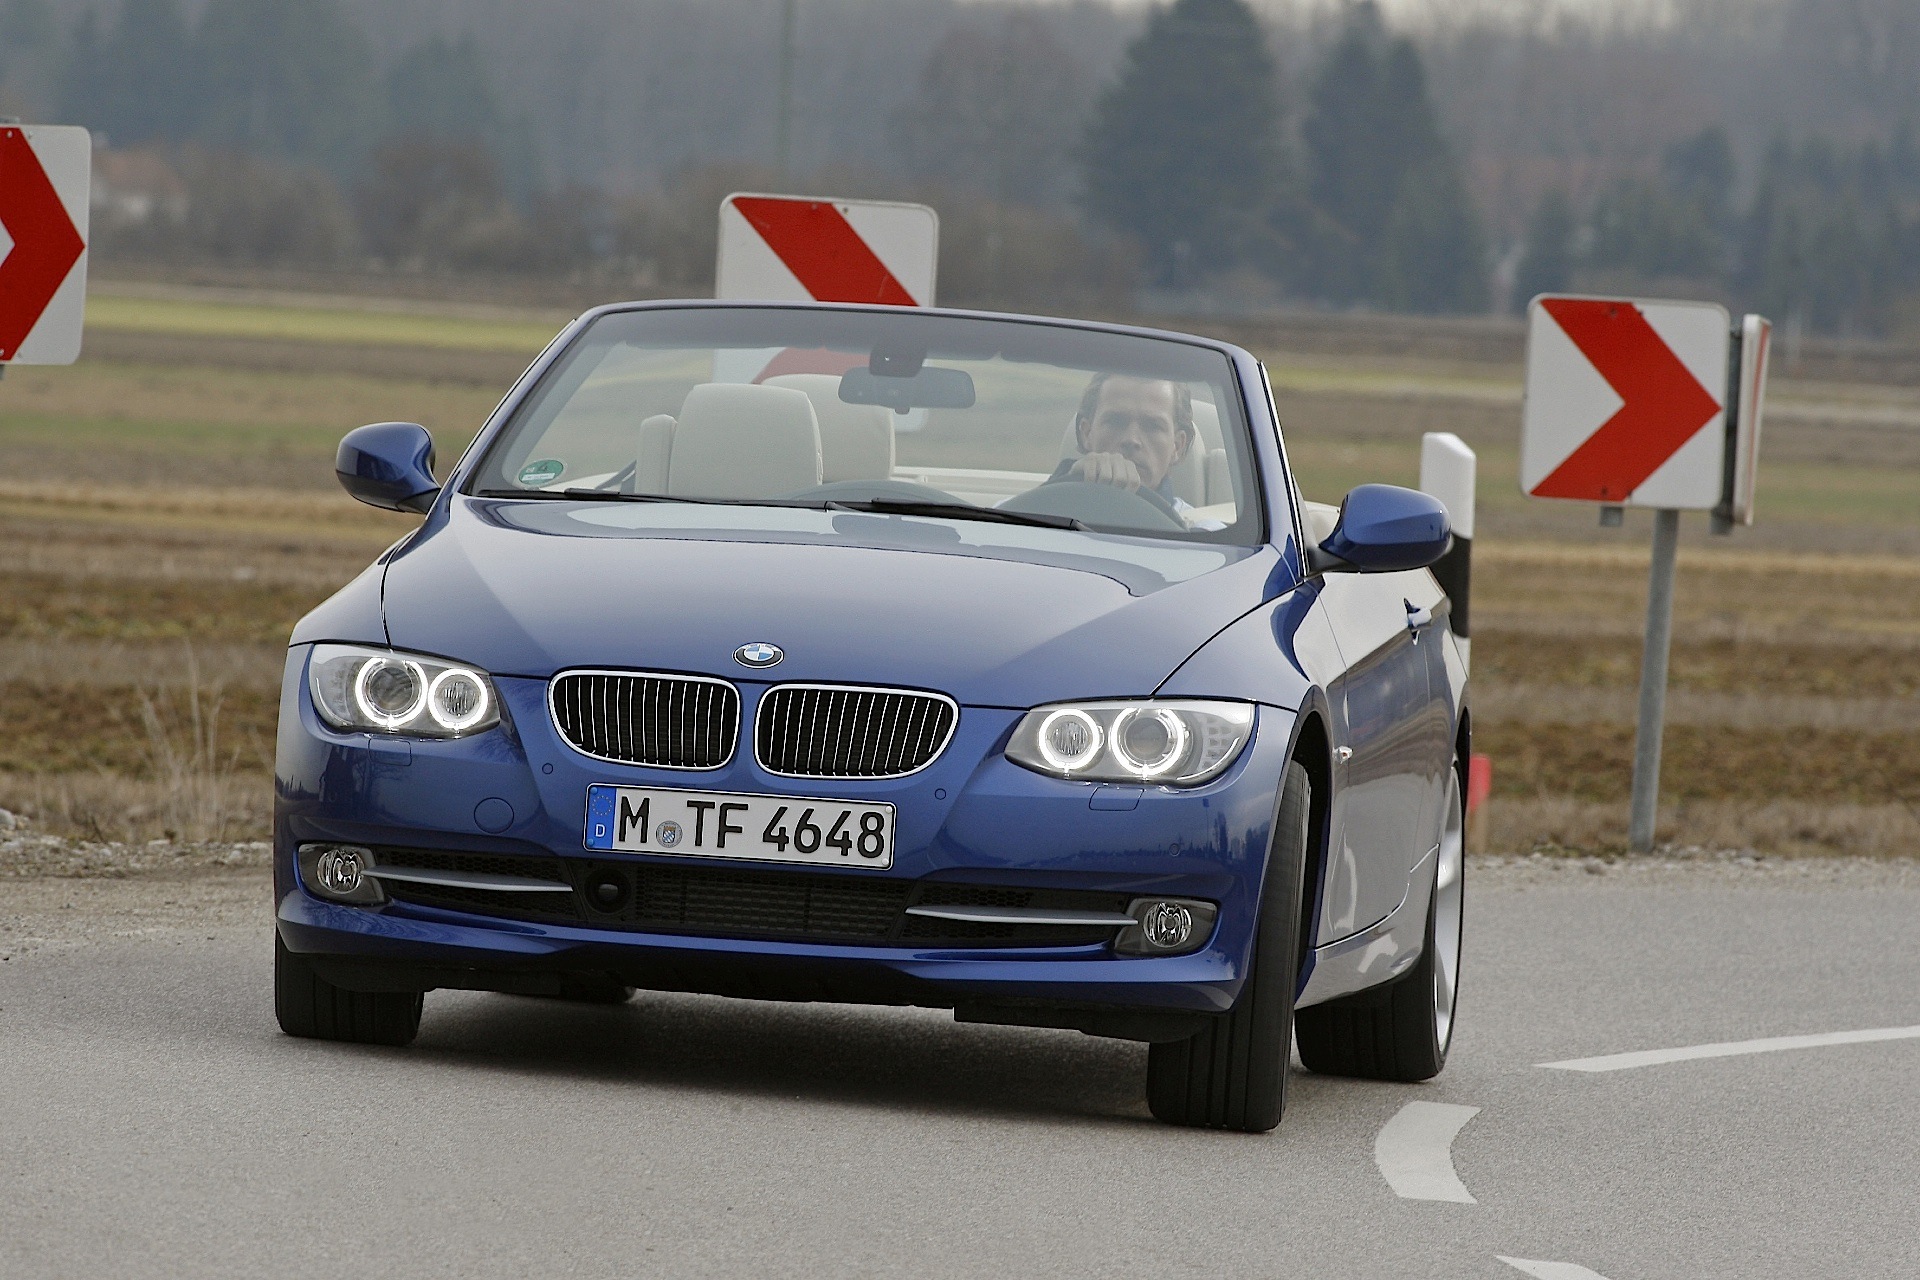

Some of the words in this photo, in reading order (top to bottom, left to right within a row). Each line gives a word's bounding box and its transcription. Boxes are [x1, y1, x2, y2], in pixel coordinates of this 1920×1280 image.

[595, 824, 605, 838] D
[618, 796, 650, 843] M
[686, 800, 749, 848] TF
[762, 806, 885, 858] 4648
